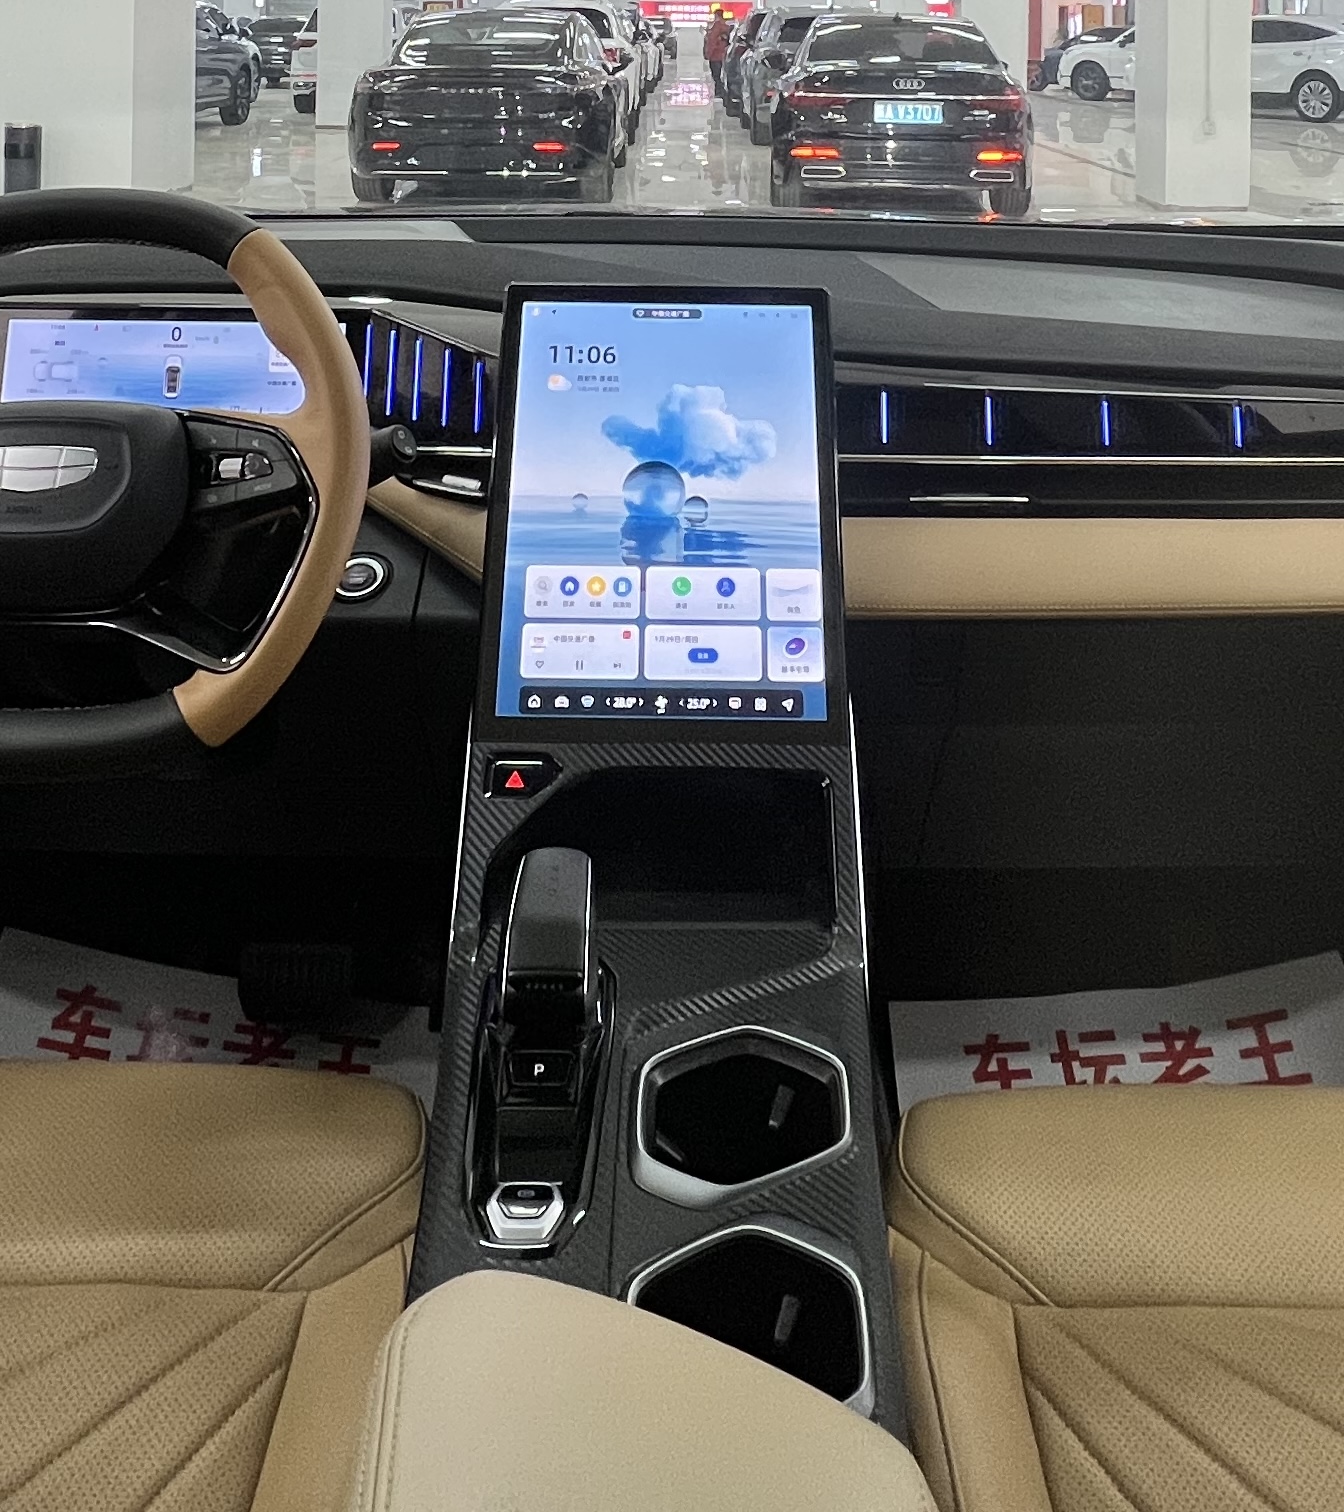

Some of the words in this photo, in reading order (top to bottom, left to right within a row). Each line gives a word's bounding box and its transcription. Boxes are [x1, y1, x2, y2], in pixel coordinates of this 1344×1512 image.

[171, 326, 182, 342] 0
[548, 345, 617, 365] 11:06
[962, 1008, 1314, 1090] 车坛老王
[533, 1062, 545, 1077] P
